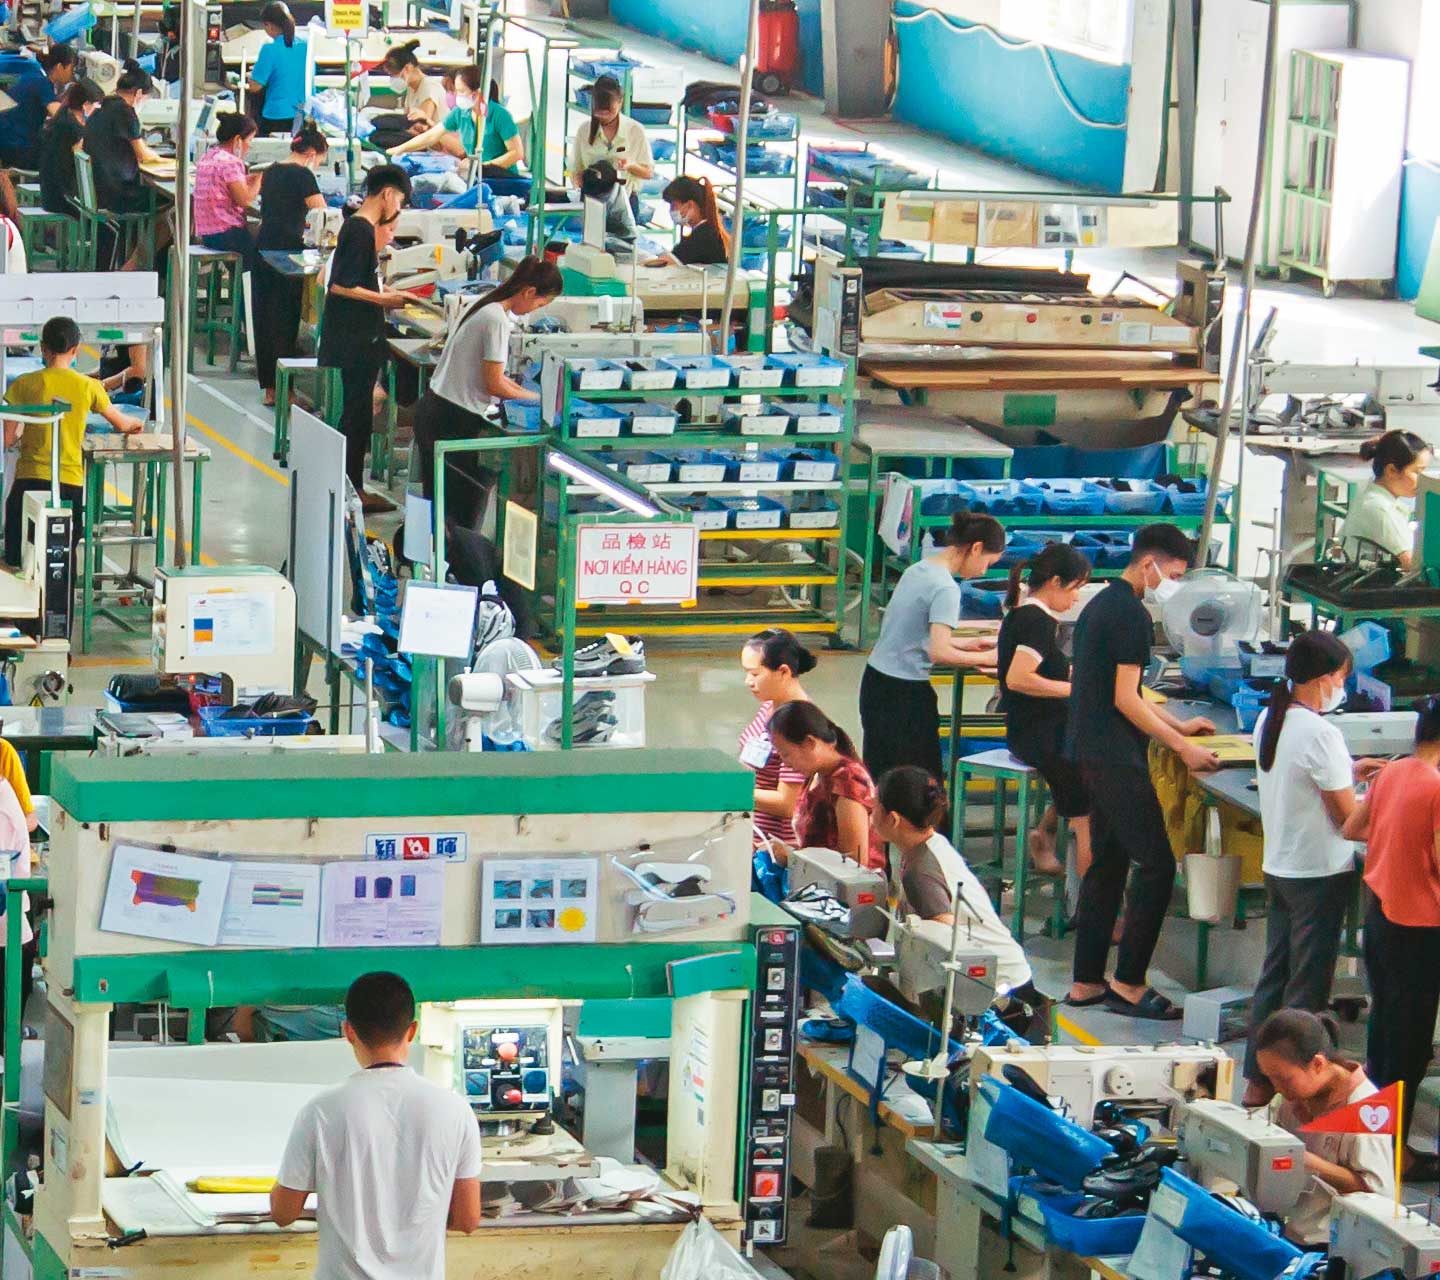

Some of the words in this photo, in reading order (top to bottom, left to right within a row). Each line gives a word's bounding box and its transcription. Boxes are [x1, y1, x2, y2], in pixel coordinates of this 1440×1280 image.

[583, 560, 609, 576] NƠI
[619, 580, 632, 595] Q
[637, 580, 649, 594] C
